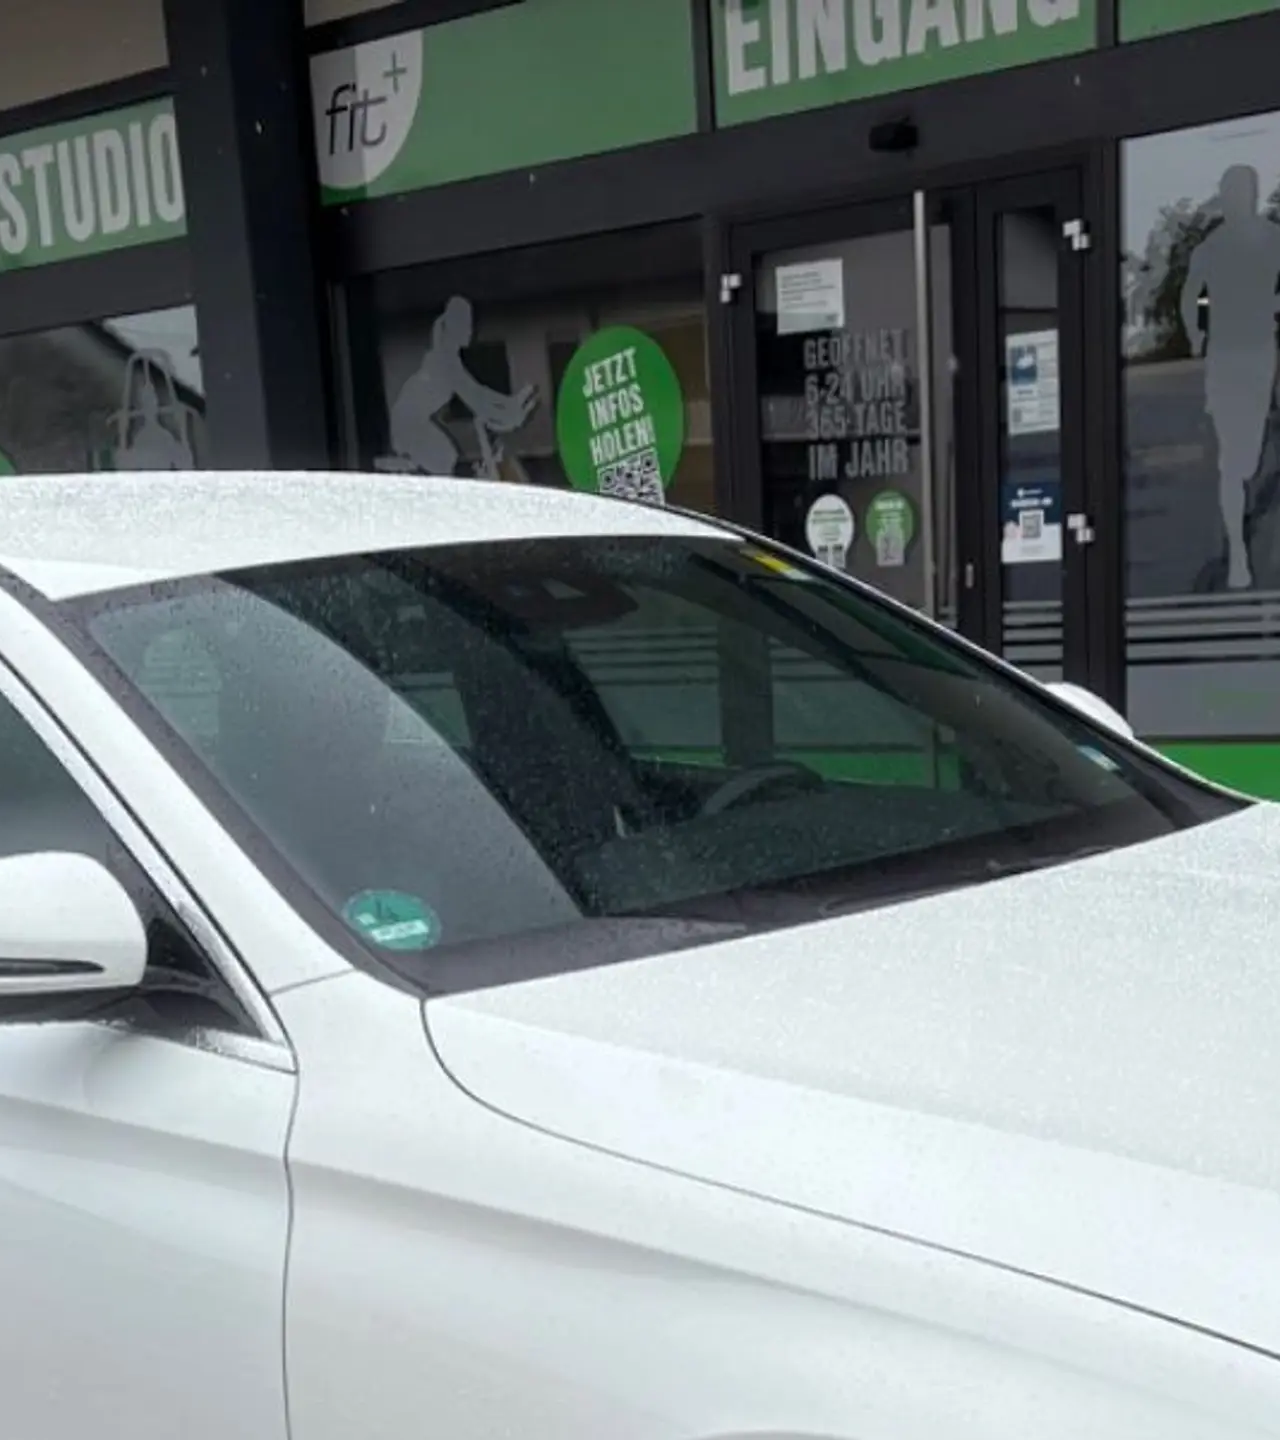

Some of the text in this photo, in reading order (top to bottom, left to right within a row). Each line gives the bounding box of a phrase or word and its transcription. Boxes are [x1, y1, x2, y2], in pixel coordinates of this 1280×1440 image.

[582, 346, 637, 398] JETZT
[588, 381, 645, 432] INFOS
[854, 400, 908, 436] TAGE
[808, 437, 909, 481] IM JAHR
